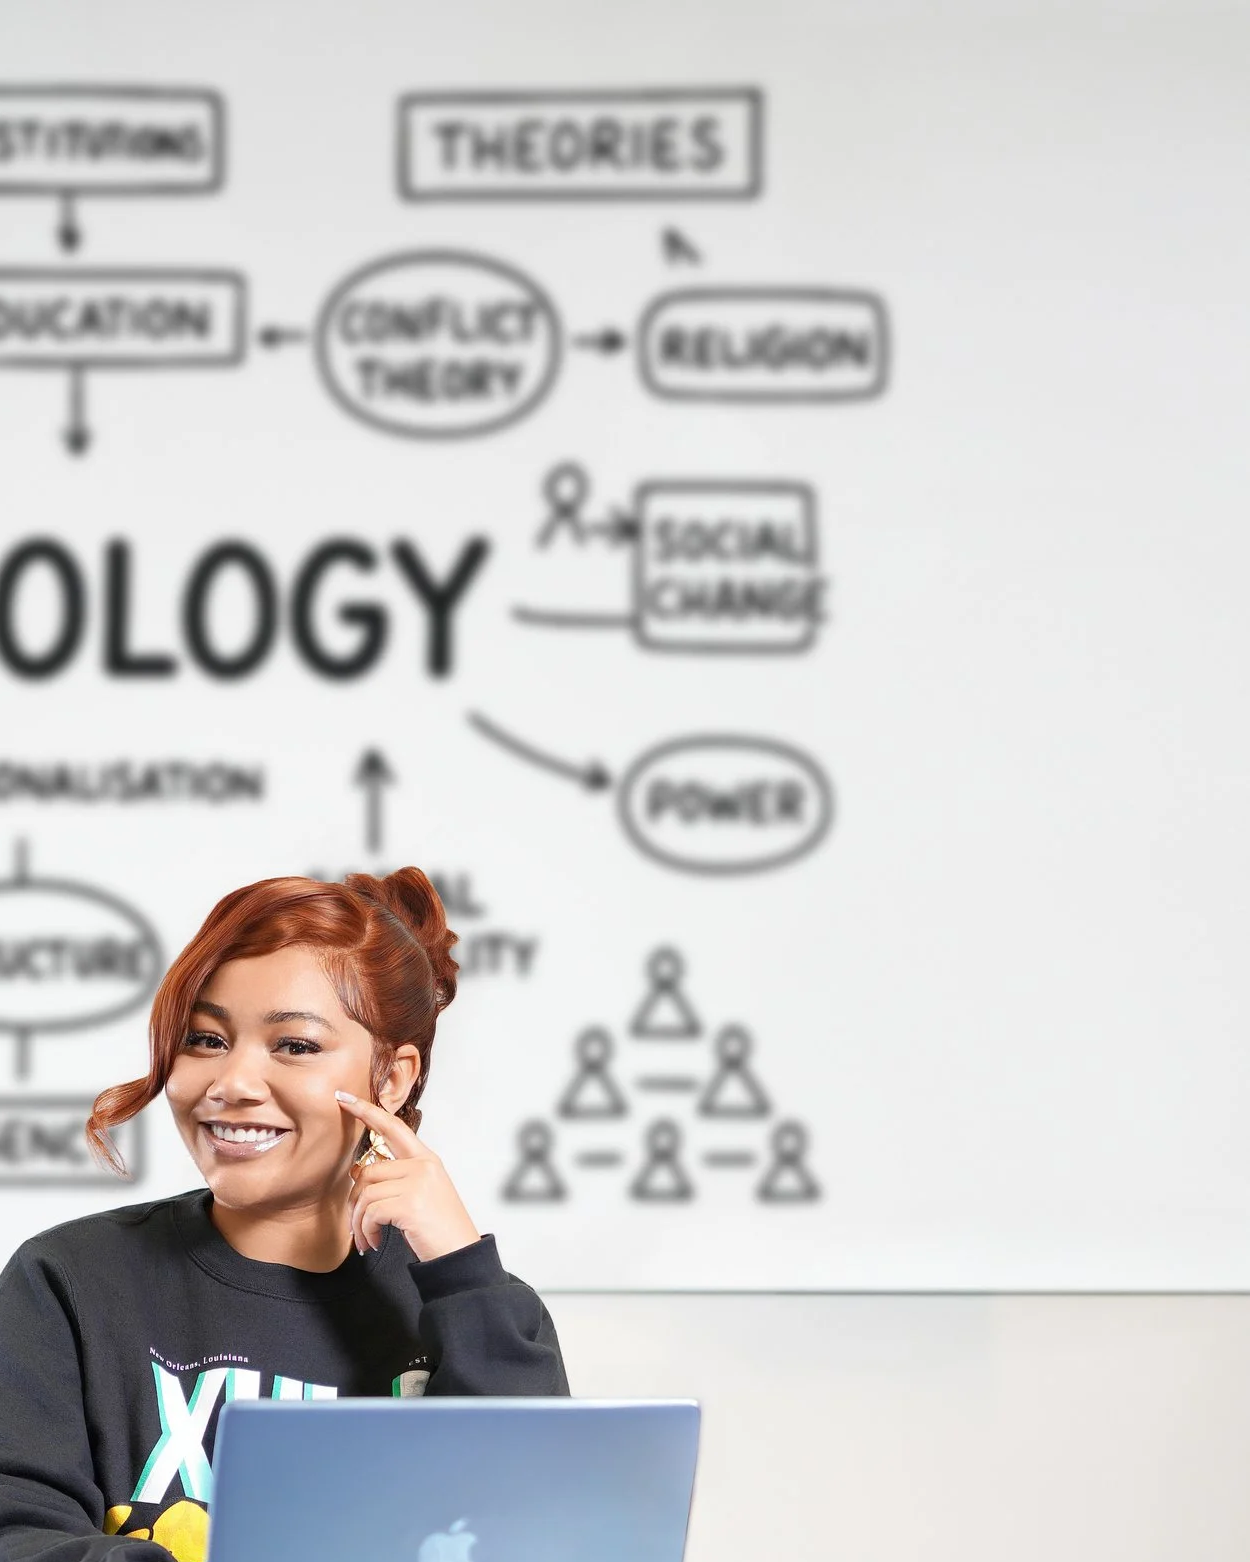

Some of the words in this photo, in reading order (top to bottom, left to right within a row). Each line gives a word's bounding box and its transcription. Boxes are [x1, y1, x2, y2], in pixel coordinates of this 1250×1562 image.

[432, 115, 727, 176] THEORIES
[338, 297, 543, 346] CONFLICT
[658, 325, 872, 373] RELIGION
[355, 357, 524, 404] THEORY
[652, 518, 808, 568] SOCIAL
[647, 576, 833, 624] CHANGE
[646, 779, 808, 828] POWER
[150, 1347, 164, 1362] New
[166, 1360, 201, 1371] Orleans,
[203, 1353, 249, 1365] Louisiana
